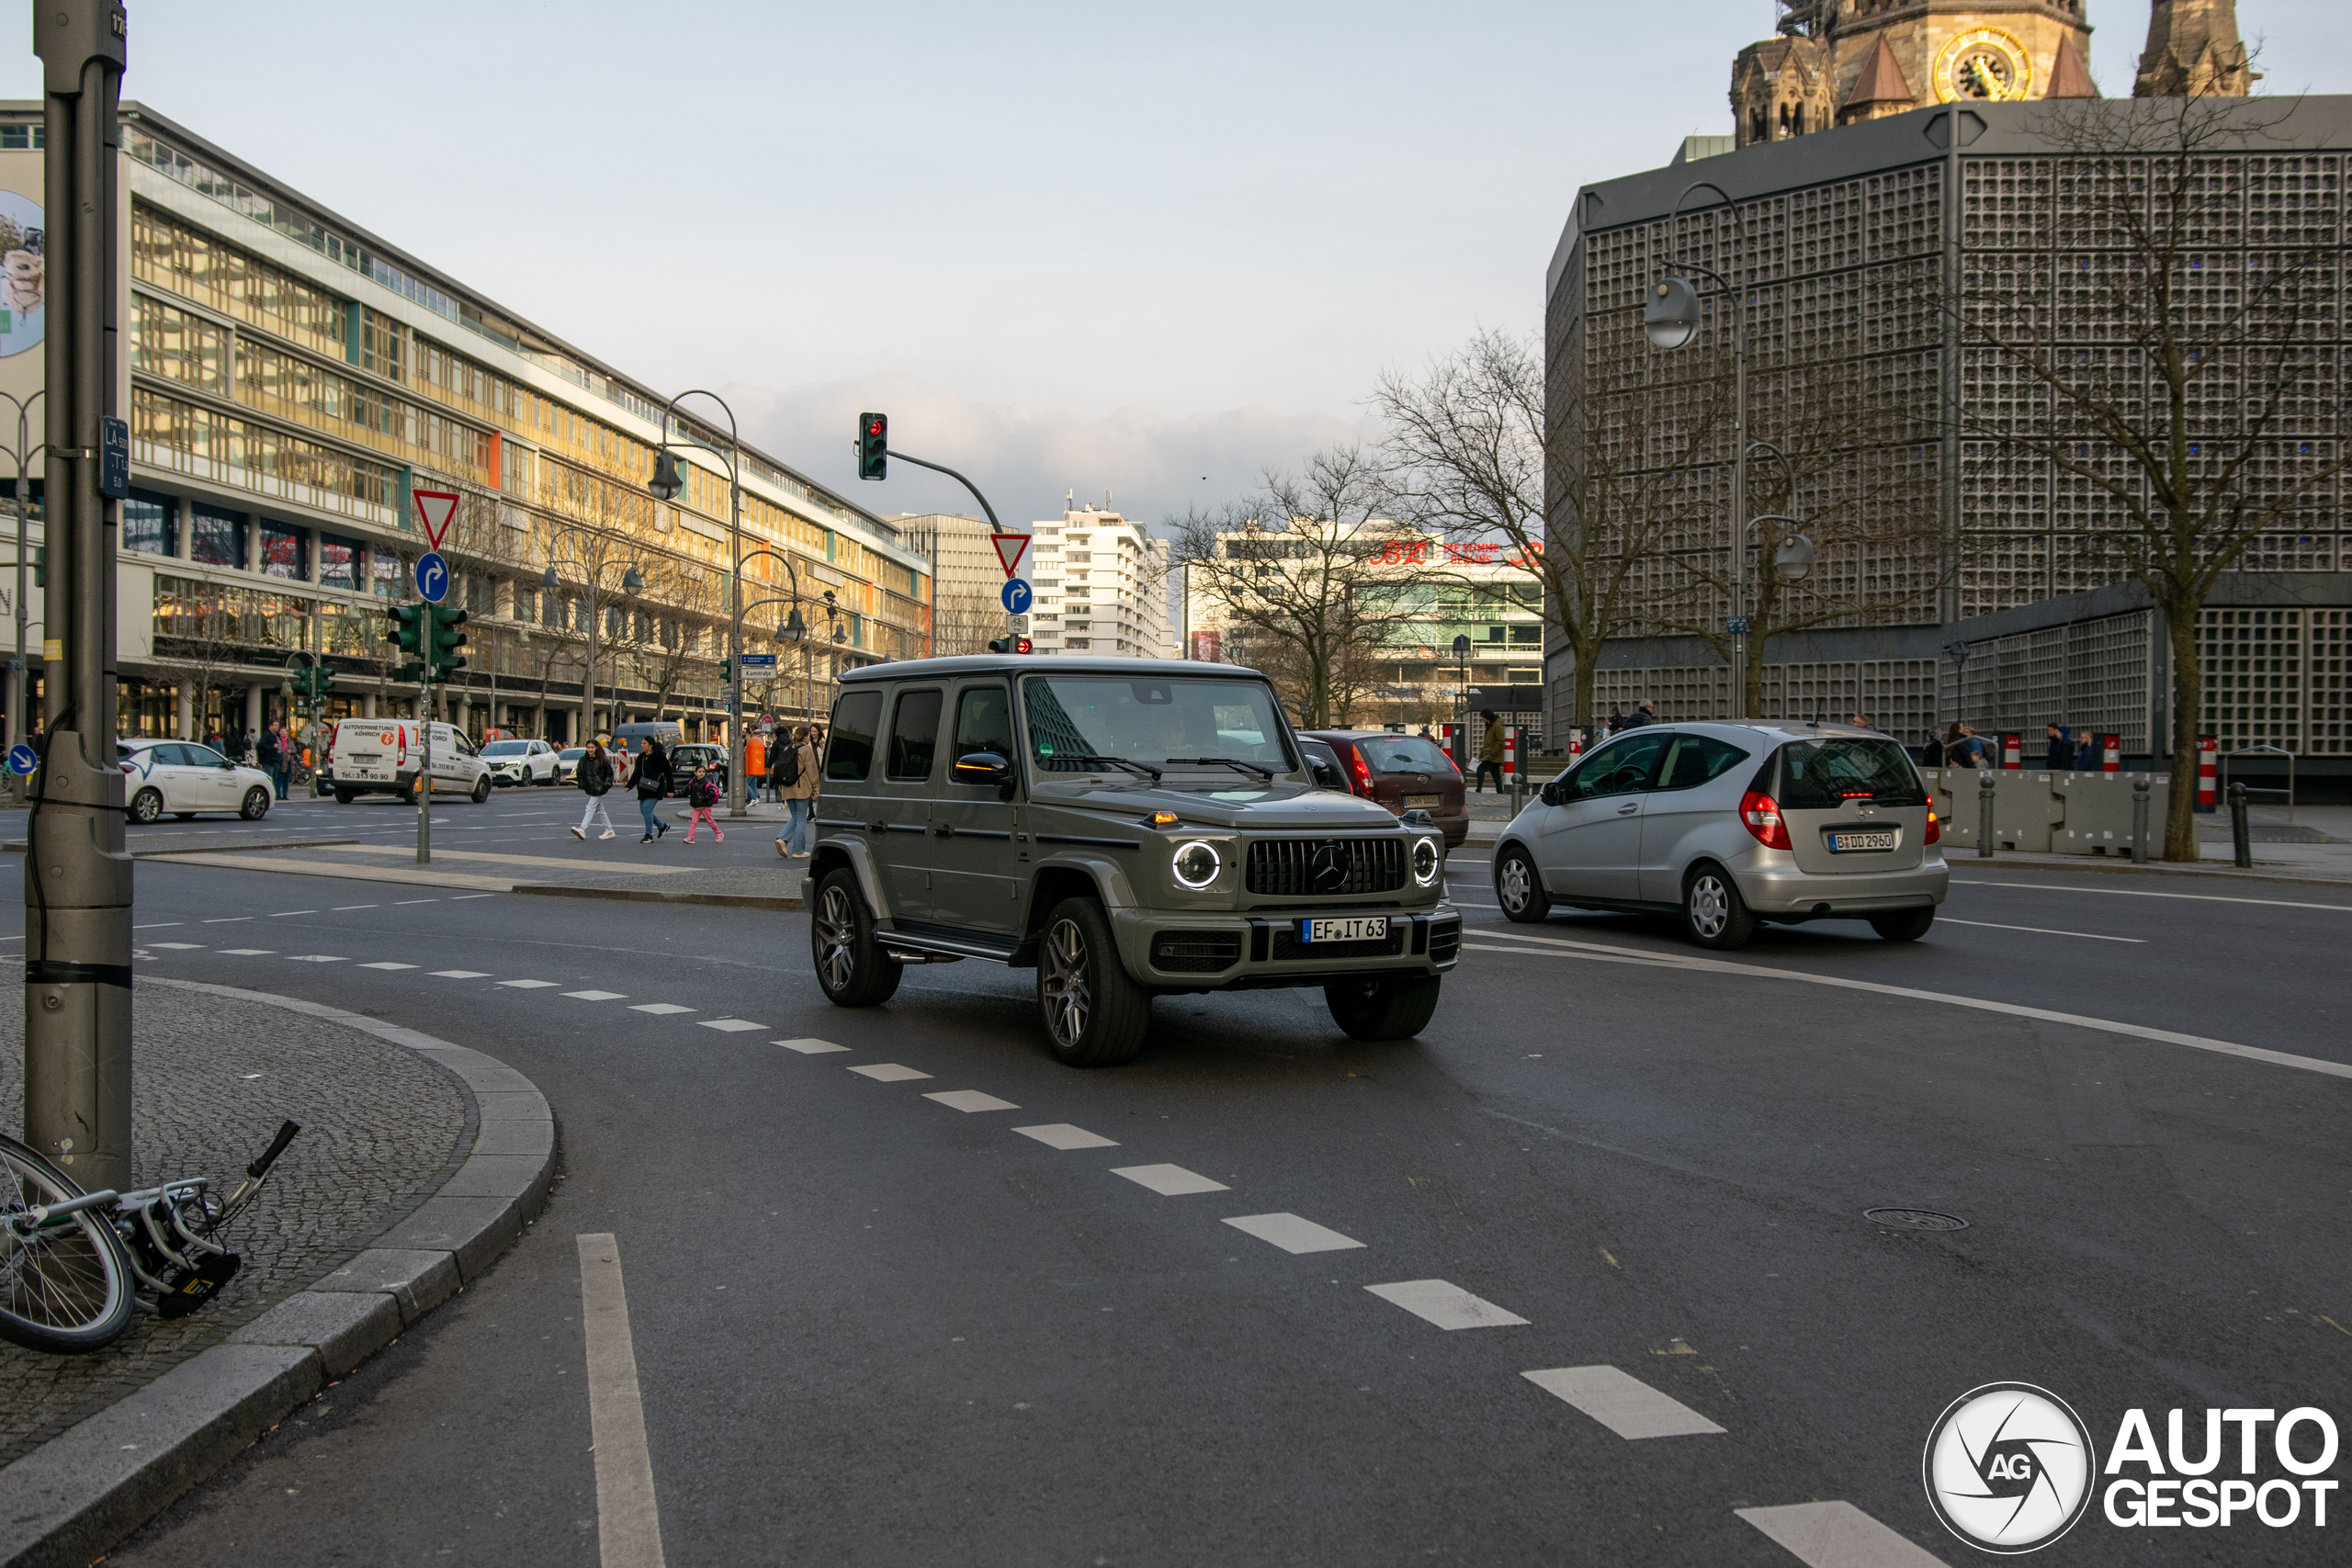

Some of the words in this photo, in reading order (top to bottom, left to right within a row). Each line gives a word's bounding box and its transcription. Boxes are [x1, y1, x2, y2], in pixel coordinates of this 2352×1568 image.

[106, 427, 118, 446] LA
[1463, 543, 1499, 553] STIMME
[1451, 555, 1492, 565] BERLINS
[1407, 797, 1411, 806] B
[1414, 796, 1421, 805] NY
[1423, 795, 1438, 805] 1020
[1837, 836, 1844, 848] B
[1850, 835, 1864, 848] DD
[1865, 835, 1892, 847] 2960
[1313, 921, 1334, 939] EF
[1344, 920, 1363, 938] IT
[1366, 919, 1385, 937] 63
